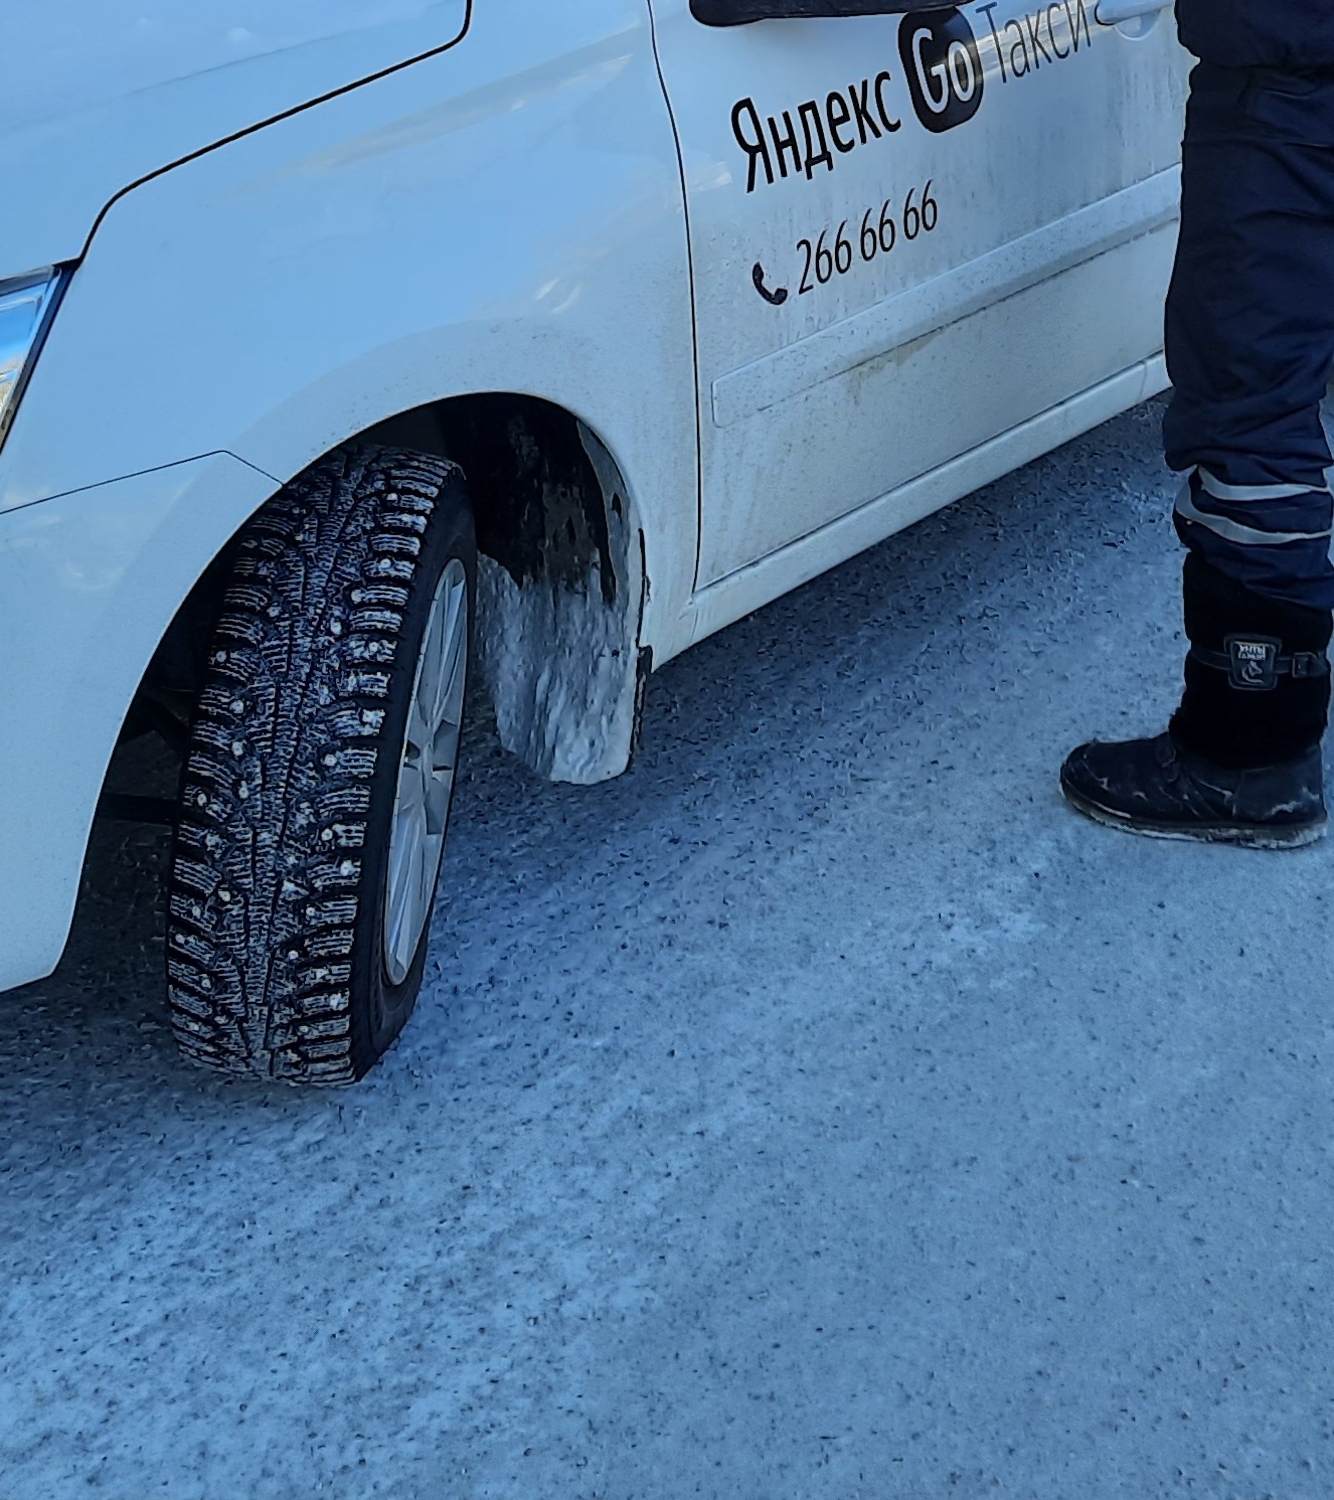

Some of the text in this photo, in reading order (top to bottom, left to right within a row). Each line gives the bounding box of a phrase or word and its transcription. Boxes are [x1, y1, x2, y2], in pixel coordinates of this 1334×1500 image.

[730, 70, 902, 194] Яндекс
[910, 24, 976, 114] Go
[795, 178, 940, 296] 266 66 66
